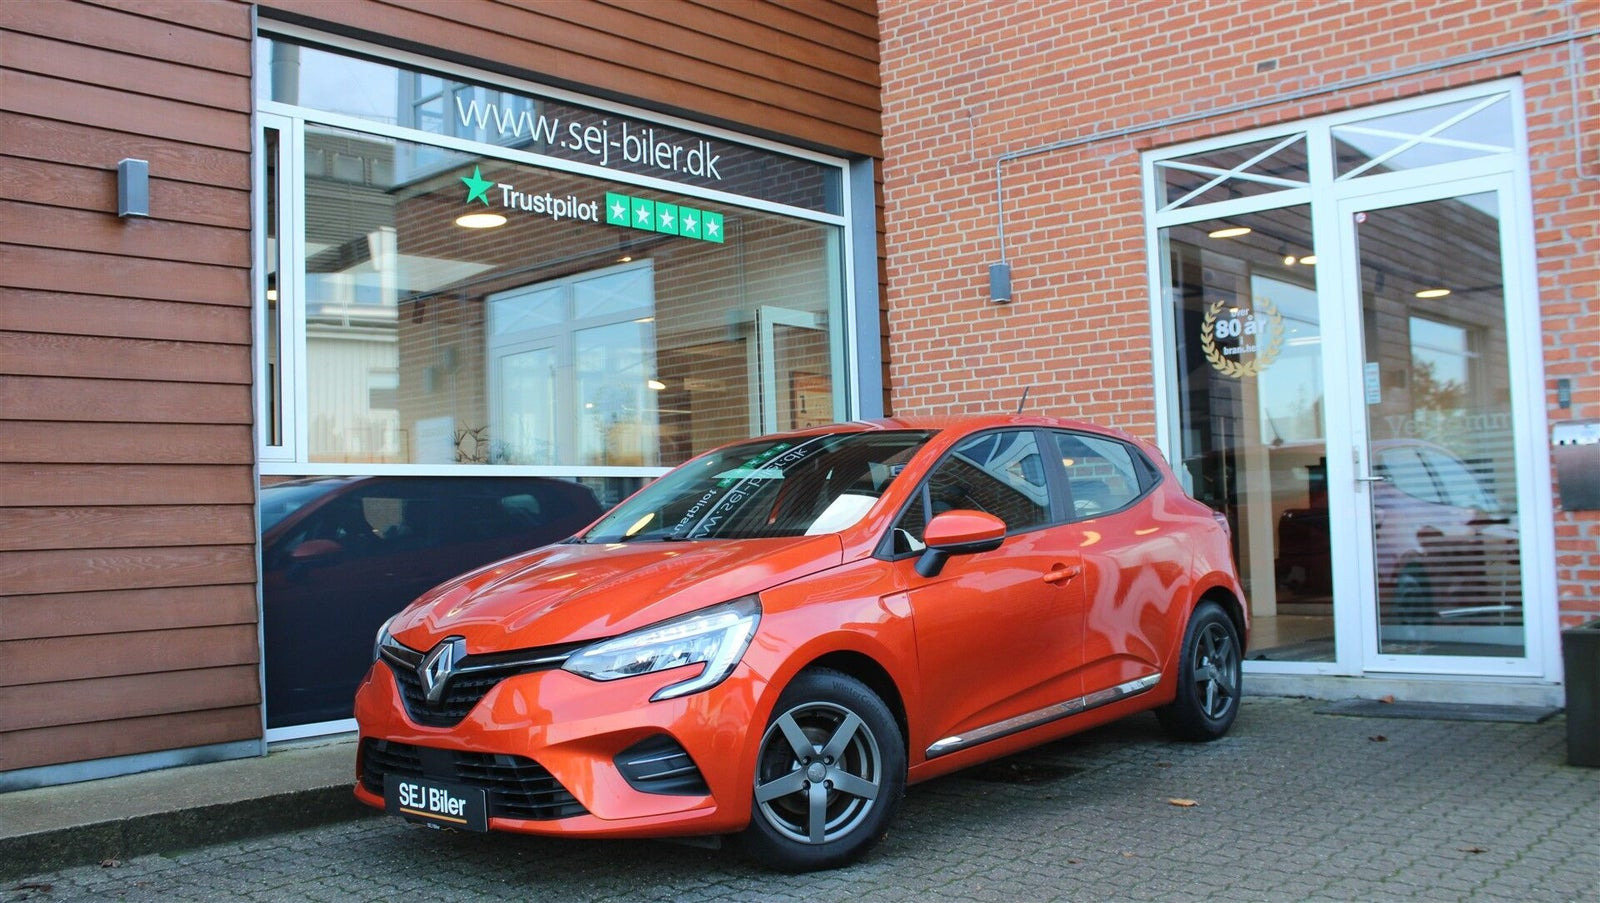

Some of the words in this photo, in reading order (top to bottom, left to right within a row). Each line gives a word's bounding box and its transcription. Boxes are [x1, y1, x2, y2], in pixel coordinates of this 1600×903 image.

[456, 96, 722, 180] www.sej-biler.dk
[498, 183, 599, 222] Trustpilot
[1215, 318, 1242, 339] 80
[398, 782, 426, 809] SEJ
[429, 787, 467, 816] Biler
